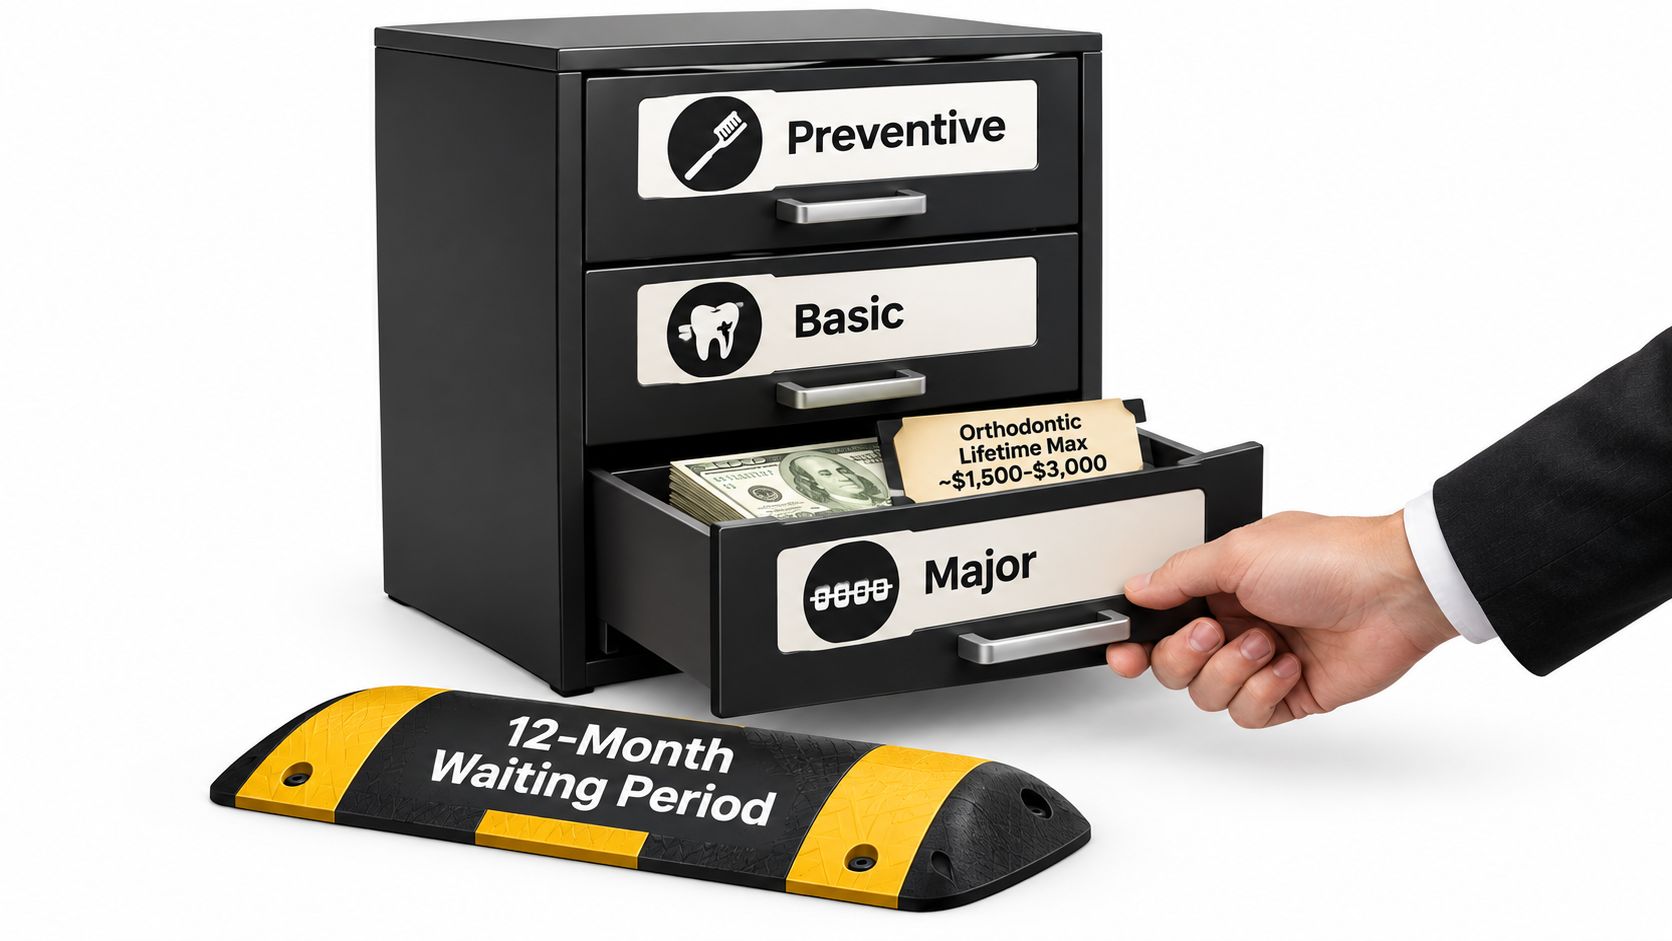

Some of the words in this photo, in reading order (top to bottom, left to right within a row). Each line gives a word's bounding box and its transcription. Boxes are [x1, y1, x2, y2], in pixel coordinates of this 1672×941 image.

[787, 109, 1006, 155] Preventive
[794, 295, 904, 338] Basic
[959, 413, 1083, 441] Orthodontic
[938, 454, 1108, 492] ~$1,500-$3,000
[959, 443, 1042, 465] Lifetime
[1046, 437, 1089, 455] Max
[924, 547, 1037, 595] Major
[507, 715, 735, 774] 12-Month
[430, 748, 609, 812] Waiting
[616, 774, 778, 827] Period
